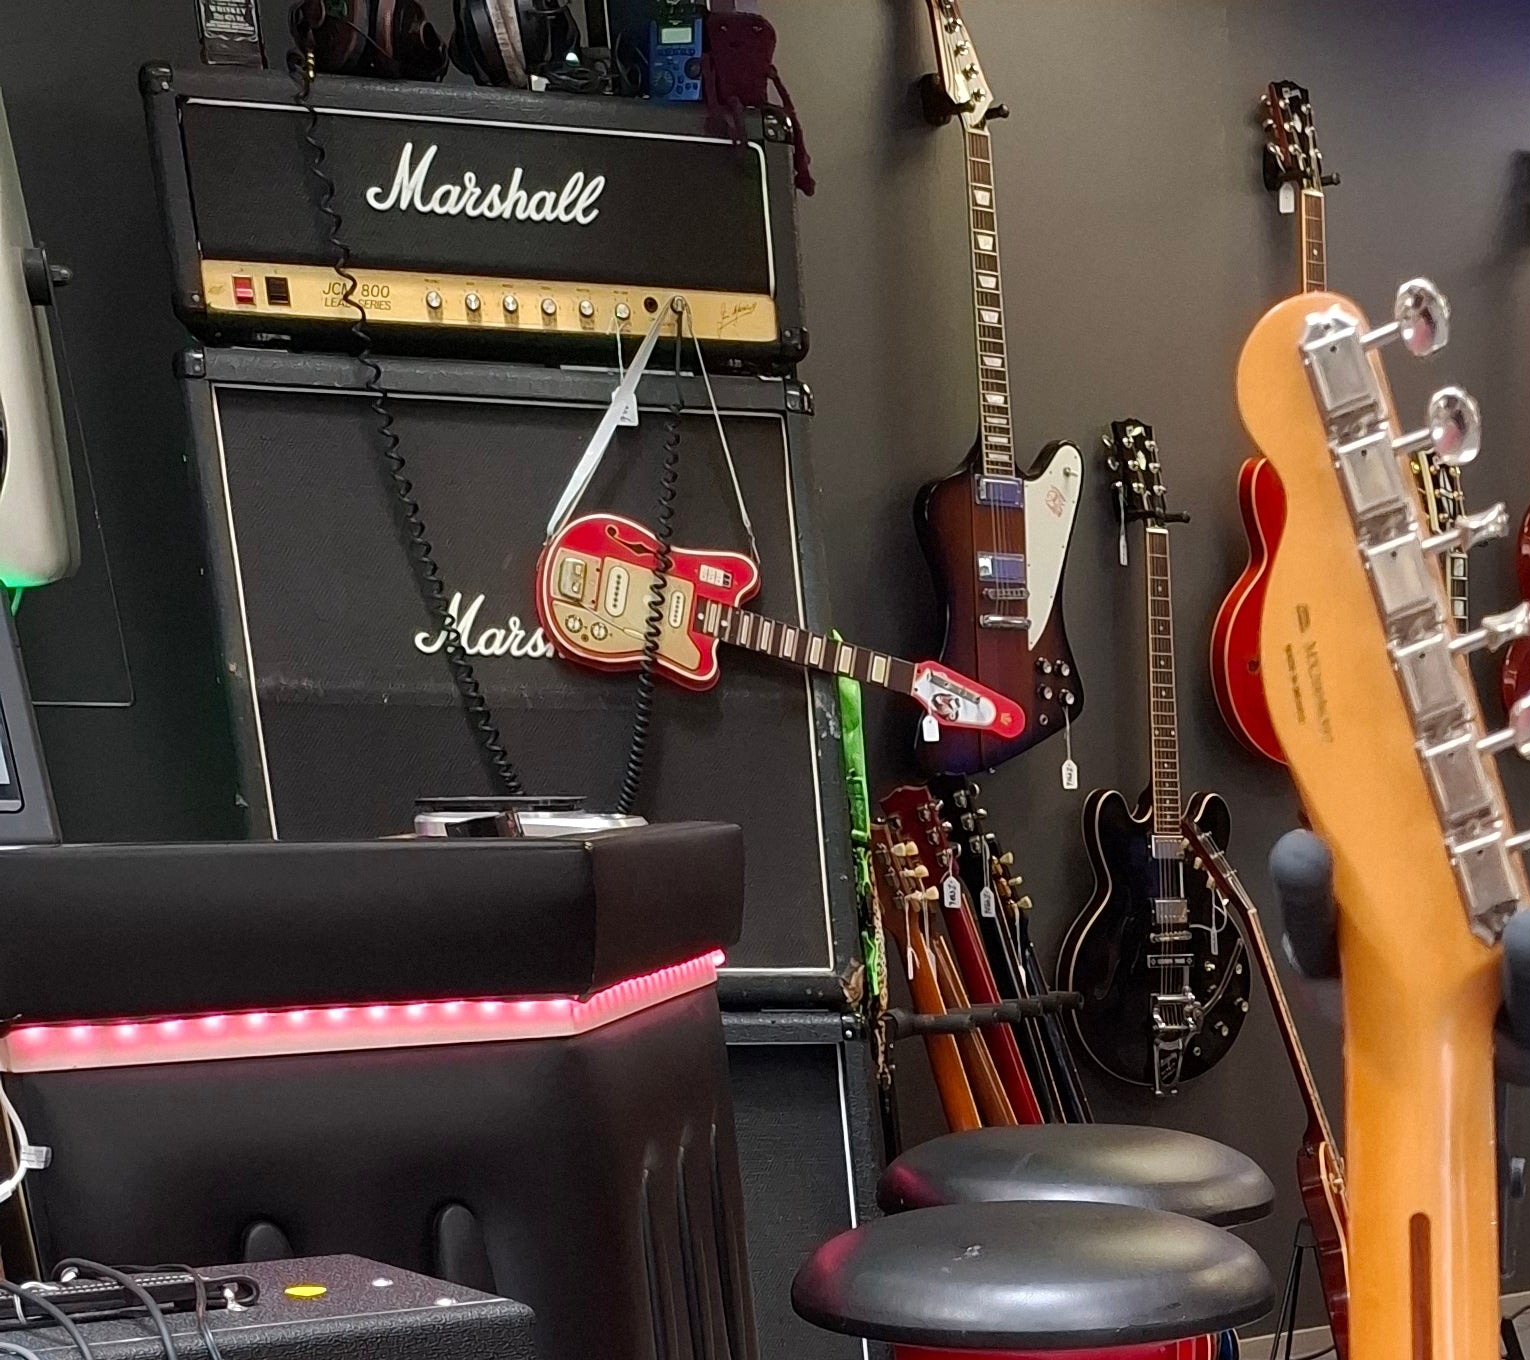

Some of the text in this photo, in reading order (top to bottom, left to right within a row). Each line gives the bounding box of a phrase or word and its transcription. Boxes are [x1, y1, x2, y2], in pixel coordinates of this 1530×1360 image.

[365, 141, 606, 225] Marshall
[361, 284, 390, 298] 800
[324, 297, 351, 308] LEA
